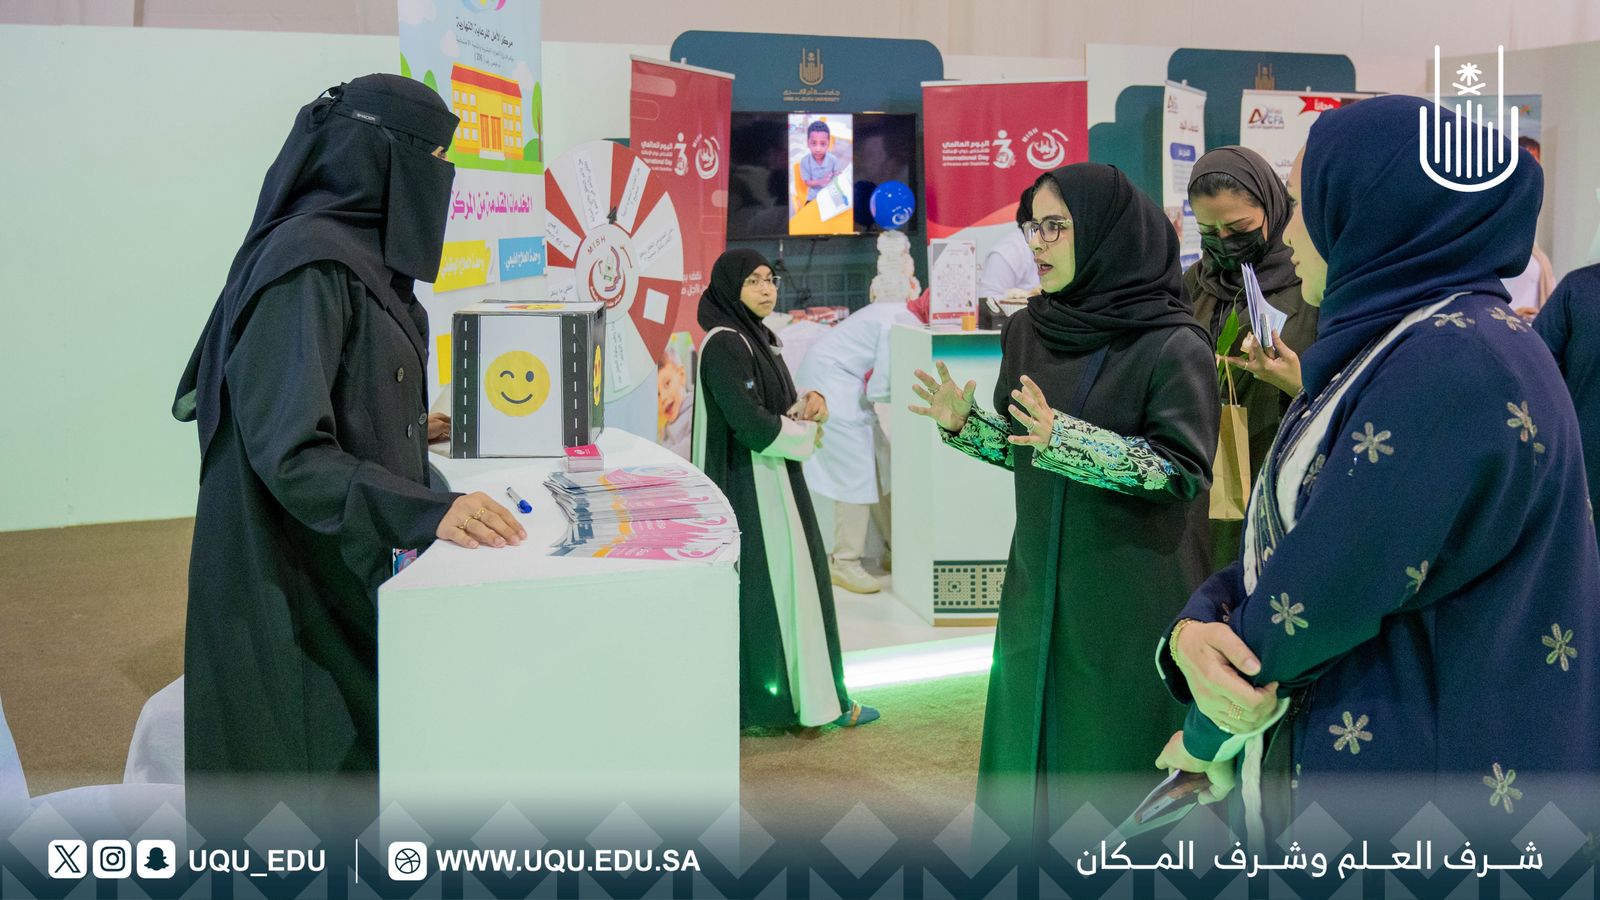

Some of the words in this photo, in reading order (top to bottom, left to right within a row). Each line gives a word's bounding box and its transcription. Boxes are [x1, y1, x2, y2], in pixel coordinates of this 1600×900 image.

[942, 140, 970, 149] العالمي
[970, 140, 990, 148] اليوم
[978, 154, 990, 162] Day
[450, 191, 476, 220] المركز
[509, 192, 533, 214] الخدمات
[587, 235, 606, 254] MISH
